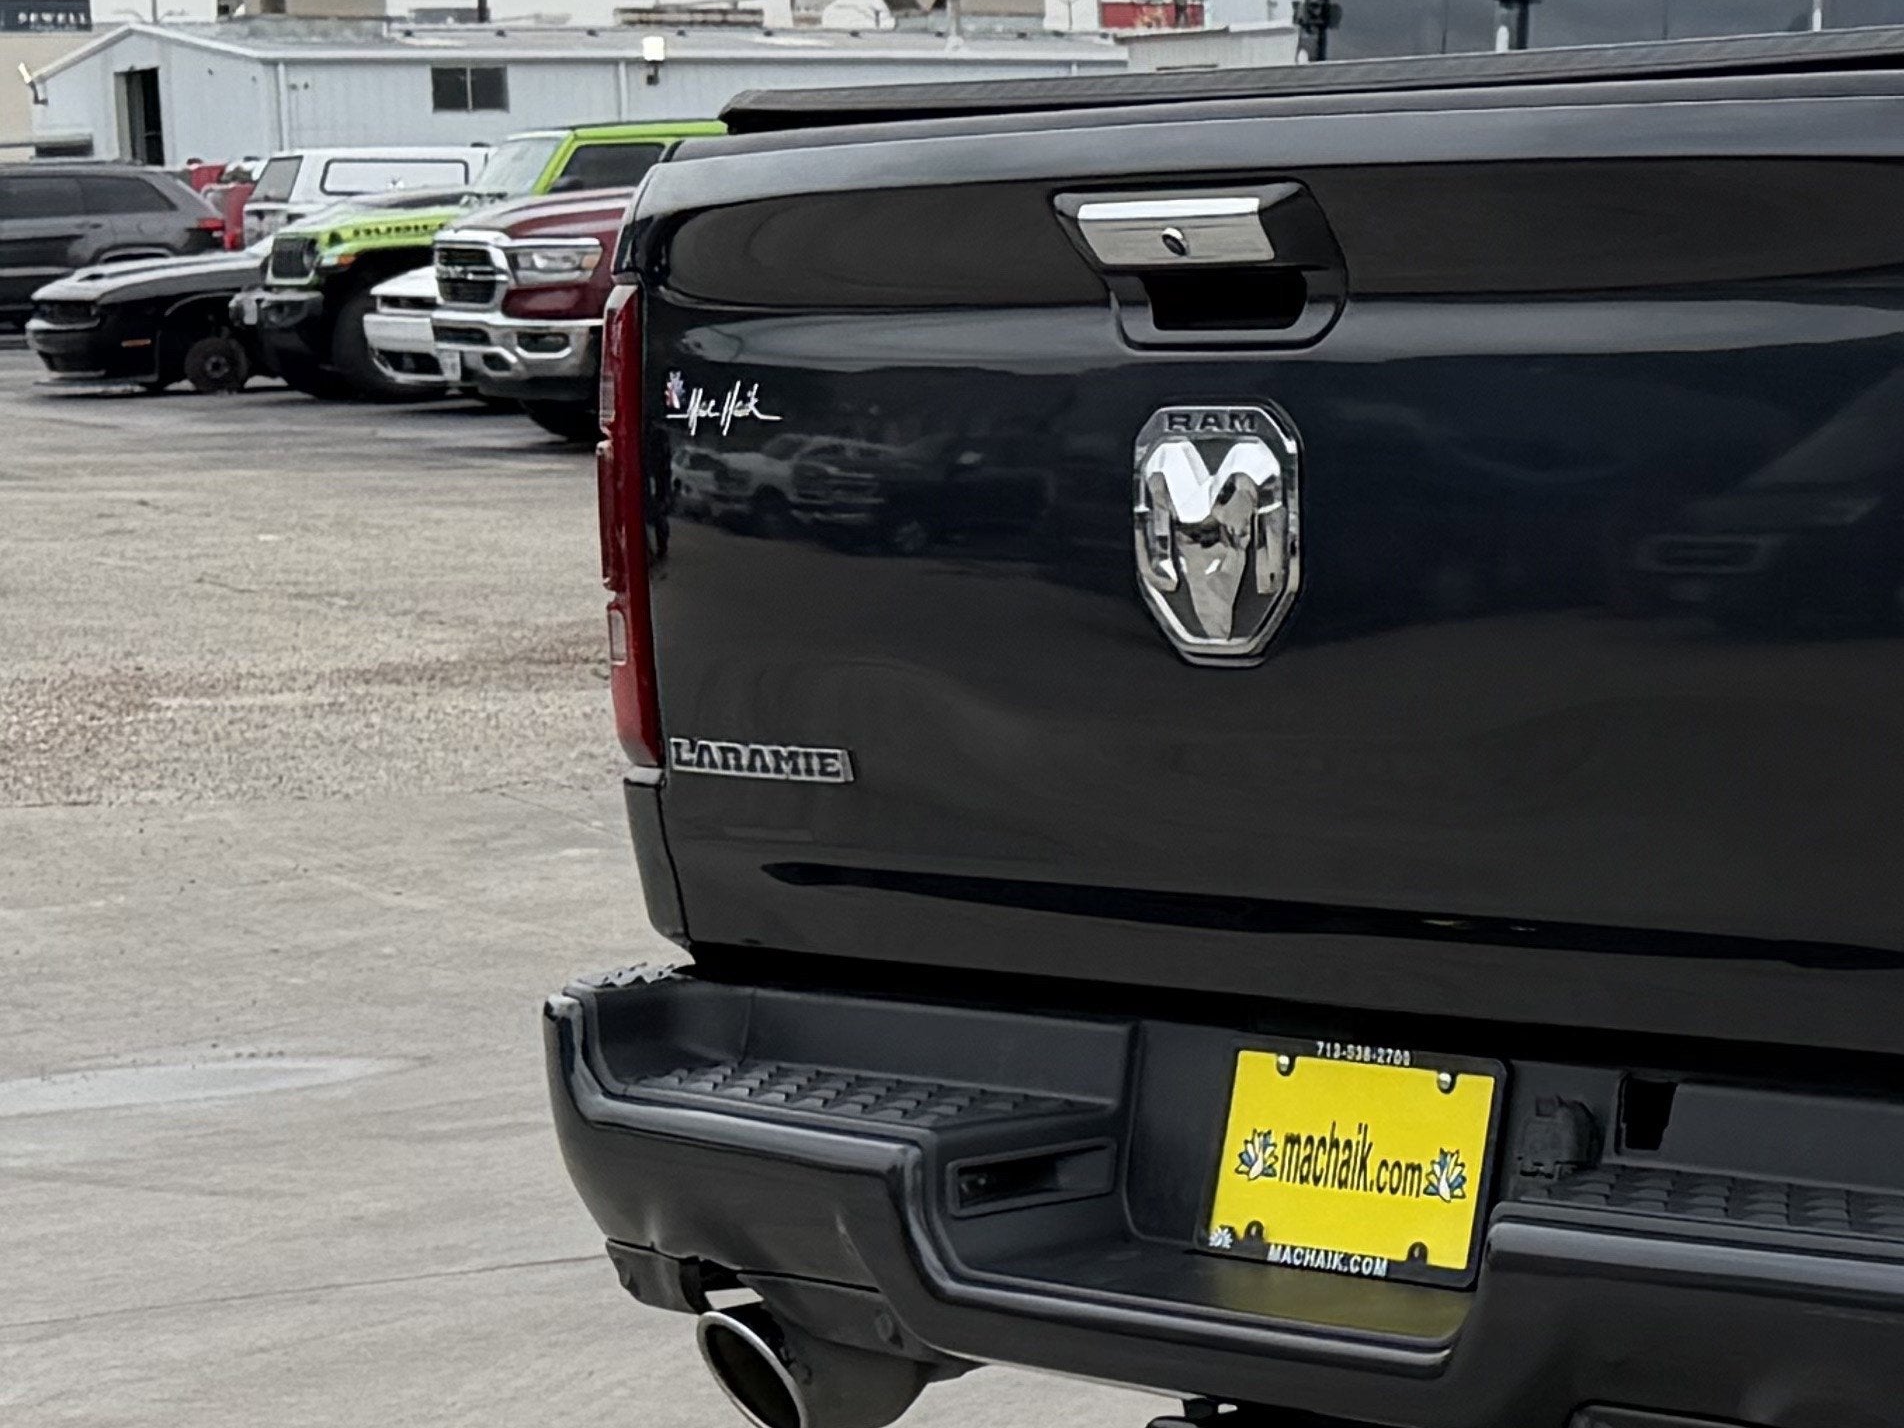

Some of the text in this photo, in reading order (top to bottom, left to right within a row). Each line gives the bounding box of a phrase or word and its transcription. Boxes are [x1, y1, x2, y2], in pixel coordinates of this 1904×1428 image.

[1165, 412, 1256, 433] RAM
[669, 736, 855, 783] LARAMIE
[1278, 1120, 1423, 1199] machaik.com
[1266, 1243, 1389, 1278] MACHAIK.COM
